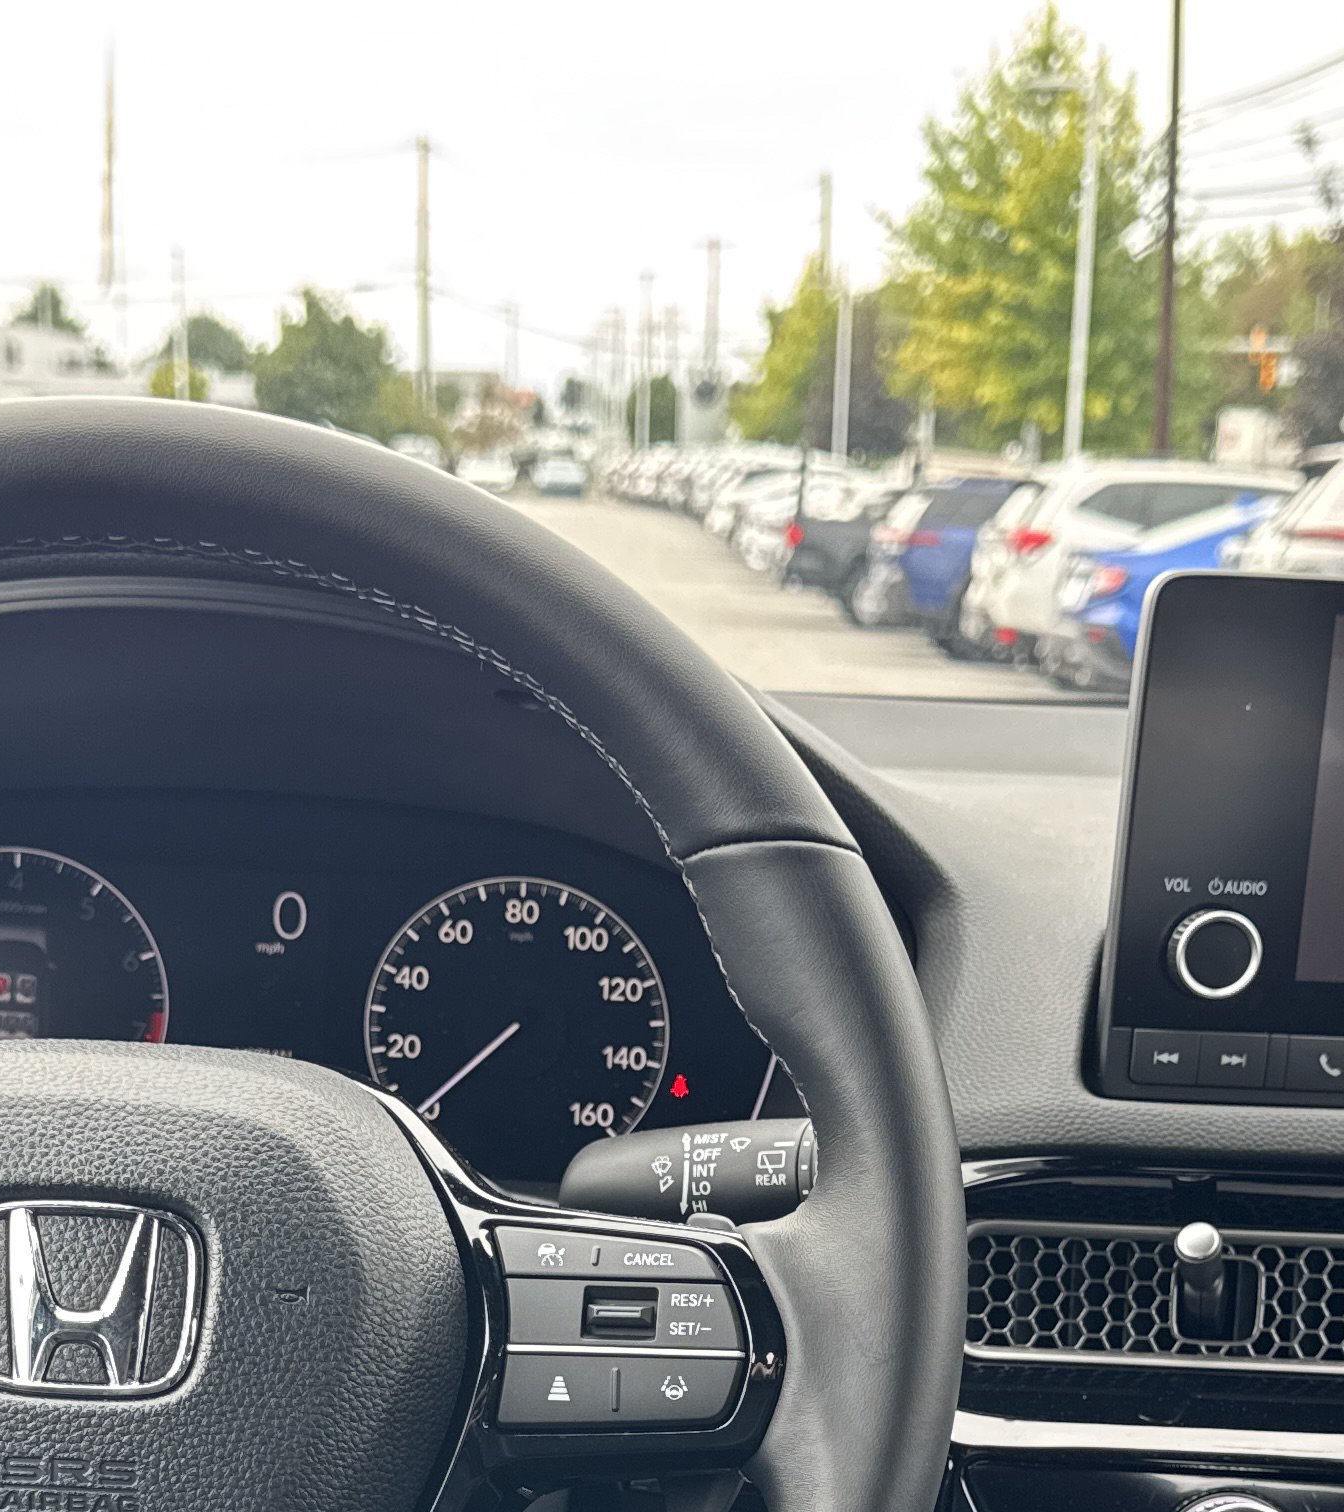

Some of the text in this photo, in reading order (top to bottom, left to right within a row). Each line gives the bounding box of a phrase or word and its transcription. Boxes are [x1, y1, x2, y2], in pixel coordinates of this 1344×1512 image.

[1164, 877, 1268, 896] VOL AUDIO
[271, 890, 308, 941] 0
[504, 899, 540, 925] 80
[437, 919, 474, 945] 60
[563, 926, 609, 952] 100
[393, 965, 430, 991] 40
[598, 976, 644, 1003] 120
[386, 1033, 422, 1059] 20
[601, 1045, 647, 1072] 140
[568, 1102, 614, 1127] 160
[693, 1132, 729, 1145] MIST
[692, 1148, 722, 1161] OFF
[692, 1164, 716, 1178] INT
[755, 1173, 787, 1187] REAR
[691, 1181, 711, 1196] LO
[691, 1200, 708, 1213] HI
[623, 1252, 675, 1267] CANCEL
[1, 1455, 138, 1487] SRS
